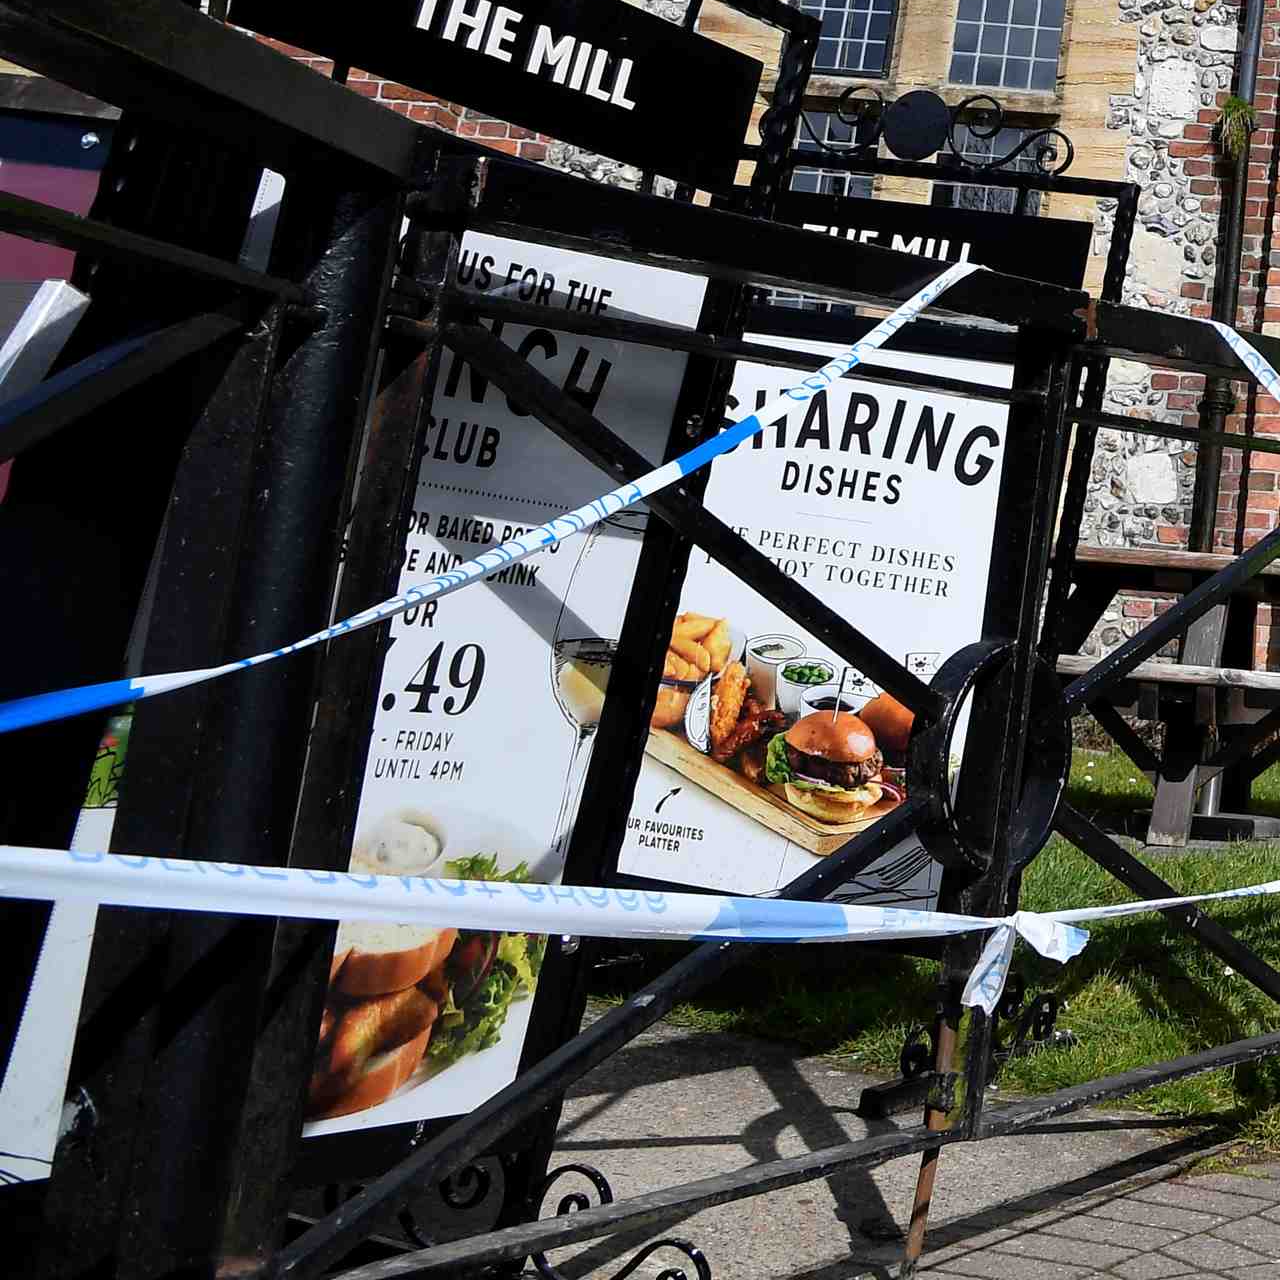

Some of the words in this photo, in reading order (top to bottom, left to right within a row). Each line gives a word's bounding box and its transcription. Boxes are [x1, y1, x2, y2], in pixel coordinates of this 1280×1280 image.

[526, 24, 635, 111] MILL
[457, 249, 495, 291] US
[503, 263, 556, 306] FOR
[781, 460, 903, 505] DISHES
[436, 515, 494, 545] BAKED
[424, 551, 464, 575] AND
[758, 529, 862, 559] PERFECT
[871, 545, 956, 573] DISHES
[825, 564, 950, 598] TOGETHER
[381, 637, 486, 716] .49
[395, 731, 454, 752] FRIDAY
[374, 758, 422, 779] UNTIL
[430, 760, 465, 782] 4PM
[638, 834, 680, 852] PLATTER
[645, 820, 704, 841] FAVOURITES
